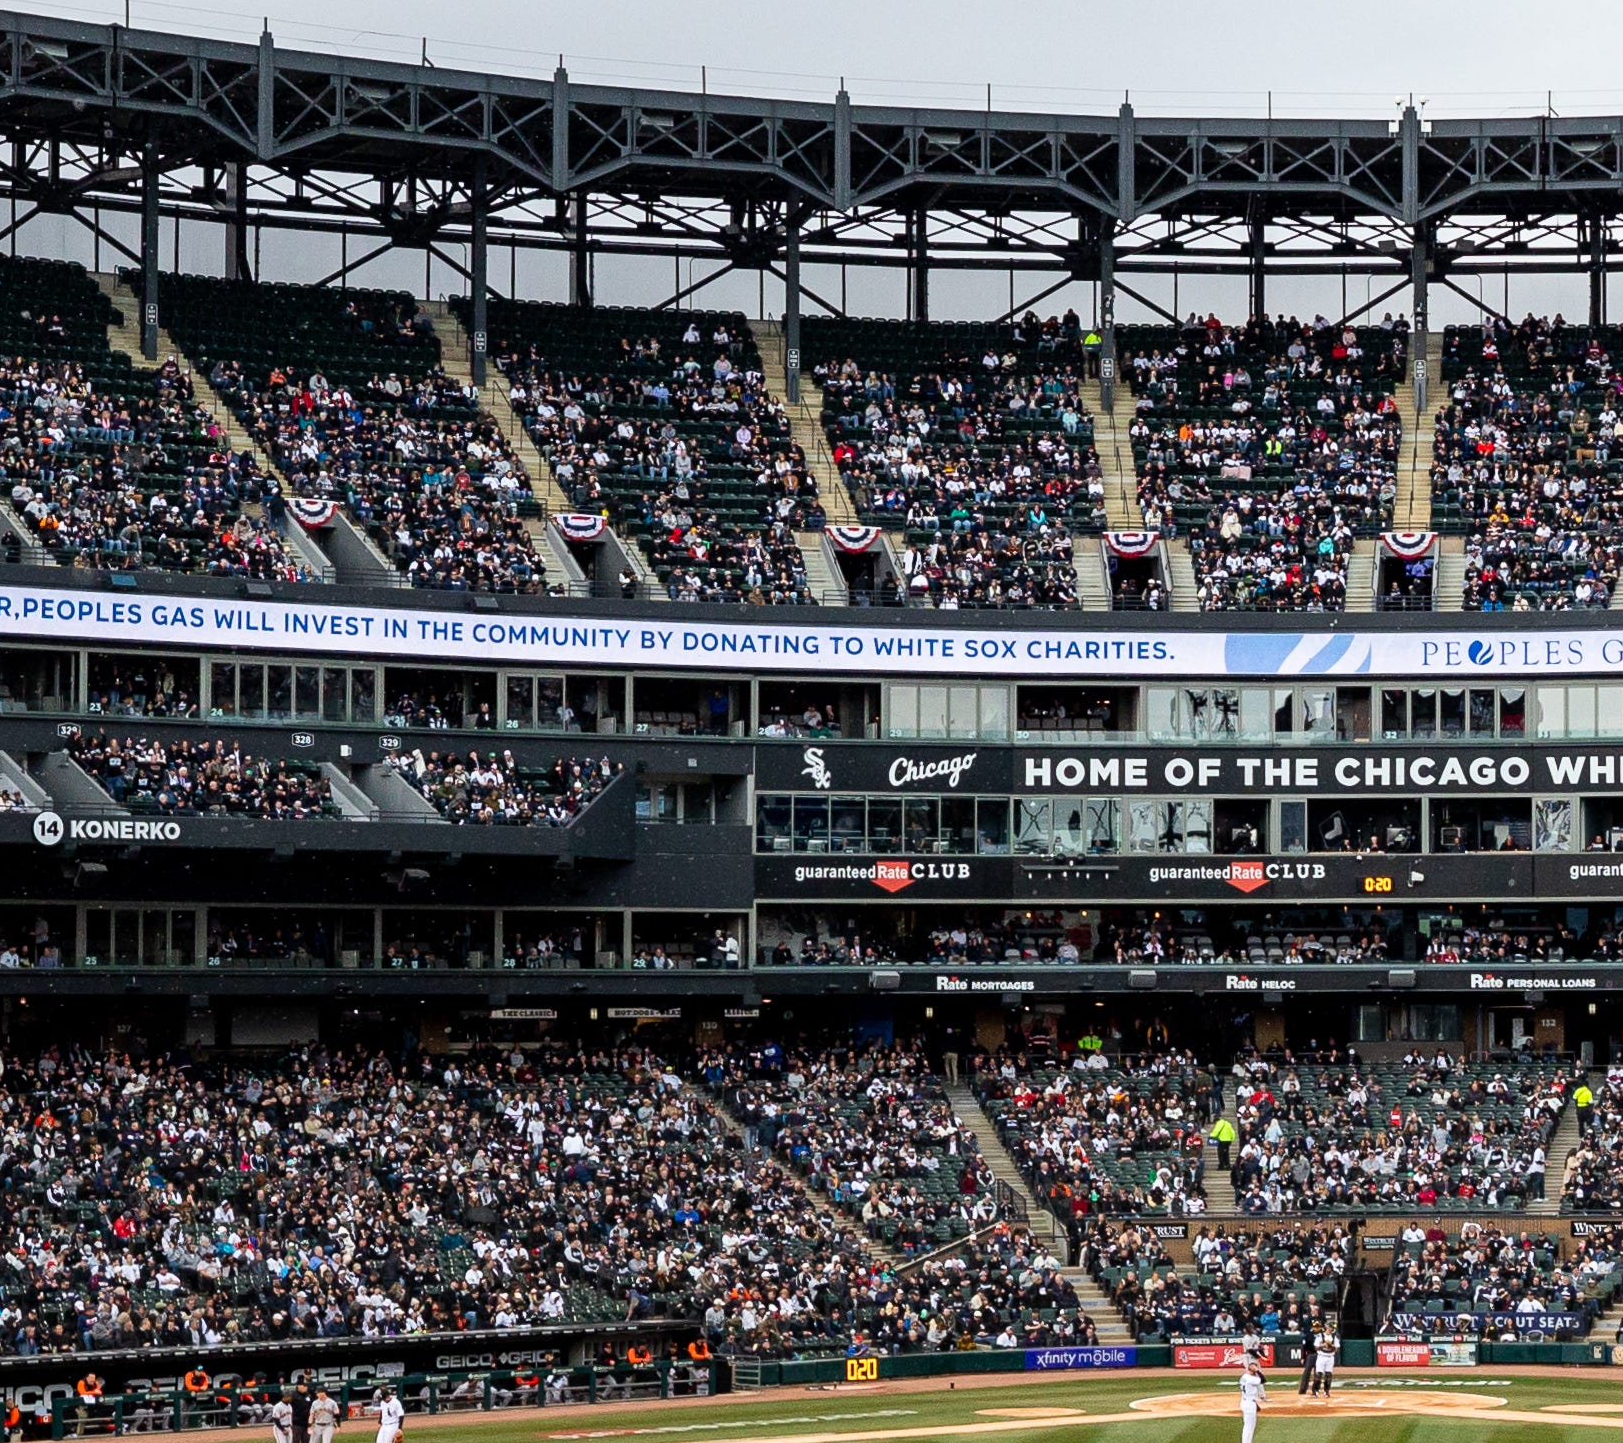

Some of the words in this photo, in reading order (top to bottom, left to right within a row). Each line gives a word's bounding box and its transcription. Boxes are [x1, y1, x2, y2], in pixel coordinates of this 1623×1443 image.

[151, 604, 205, 628] GAS
[213, 608, 275, 632] WILL
[284, 612, 375, 637] INVEST
[384, 617, 408, 639] IN
[416, 619, 464, 642] THE
[472, 623, 631, 648] COMMUNITY
[641, 635, 674, 650] BY
[683, 631, 819, 655] DONATING
[829, 636, 864, 656] TO
[873, 637, 955, 658] WHITE
[964, 639, 1017, 659] SOX
[1026, 640, 1175, 660] CHARITIES.
[295, 736, 311, 745] 328
[382, 739, 398, 747] 329
[889, 753, 976, 787] Chicago
[1025, 758, 1147, 786] HOME
[1165, 758, 1221, 786] OF
[1237, 758, 1318, 786] THE
[1335, 757, 1529, 786] CHICAGO
[39, 821, 58, 836] 14
[71, 820, 180, 840] KONERKO
[795, 865, 876, 881] guaranteed
[878, 866, 907, 879] Rate
[911, 864, 970, 878] CLUB
[1150, 866, 1230, 882] guaranteed
[1233, 866, 1262, 879] Rate
[1266, 864, 1327, 879] CLUB
[1364, 878, 1390, 891] 0:20
[937, 976, 967, 990] Rate
[972, 981, 1034, 990] MORTGAGES
[1226, 975, 1257, 989] Rate
[1262, 981, 1295, 989] HELOC
[1471, 974, 1503, 991] Rate
[1507, 979, 1560, 991] PERSONAL
[1564, 979, 1597, 990] LOANS
[436, 1351, 494, 1369] GEICO
[1036, 1351, 1077, 1367] xfinity
